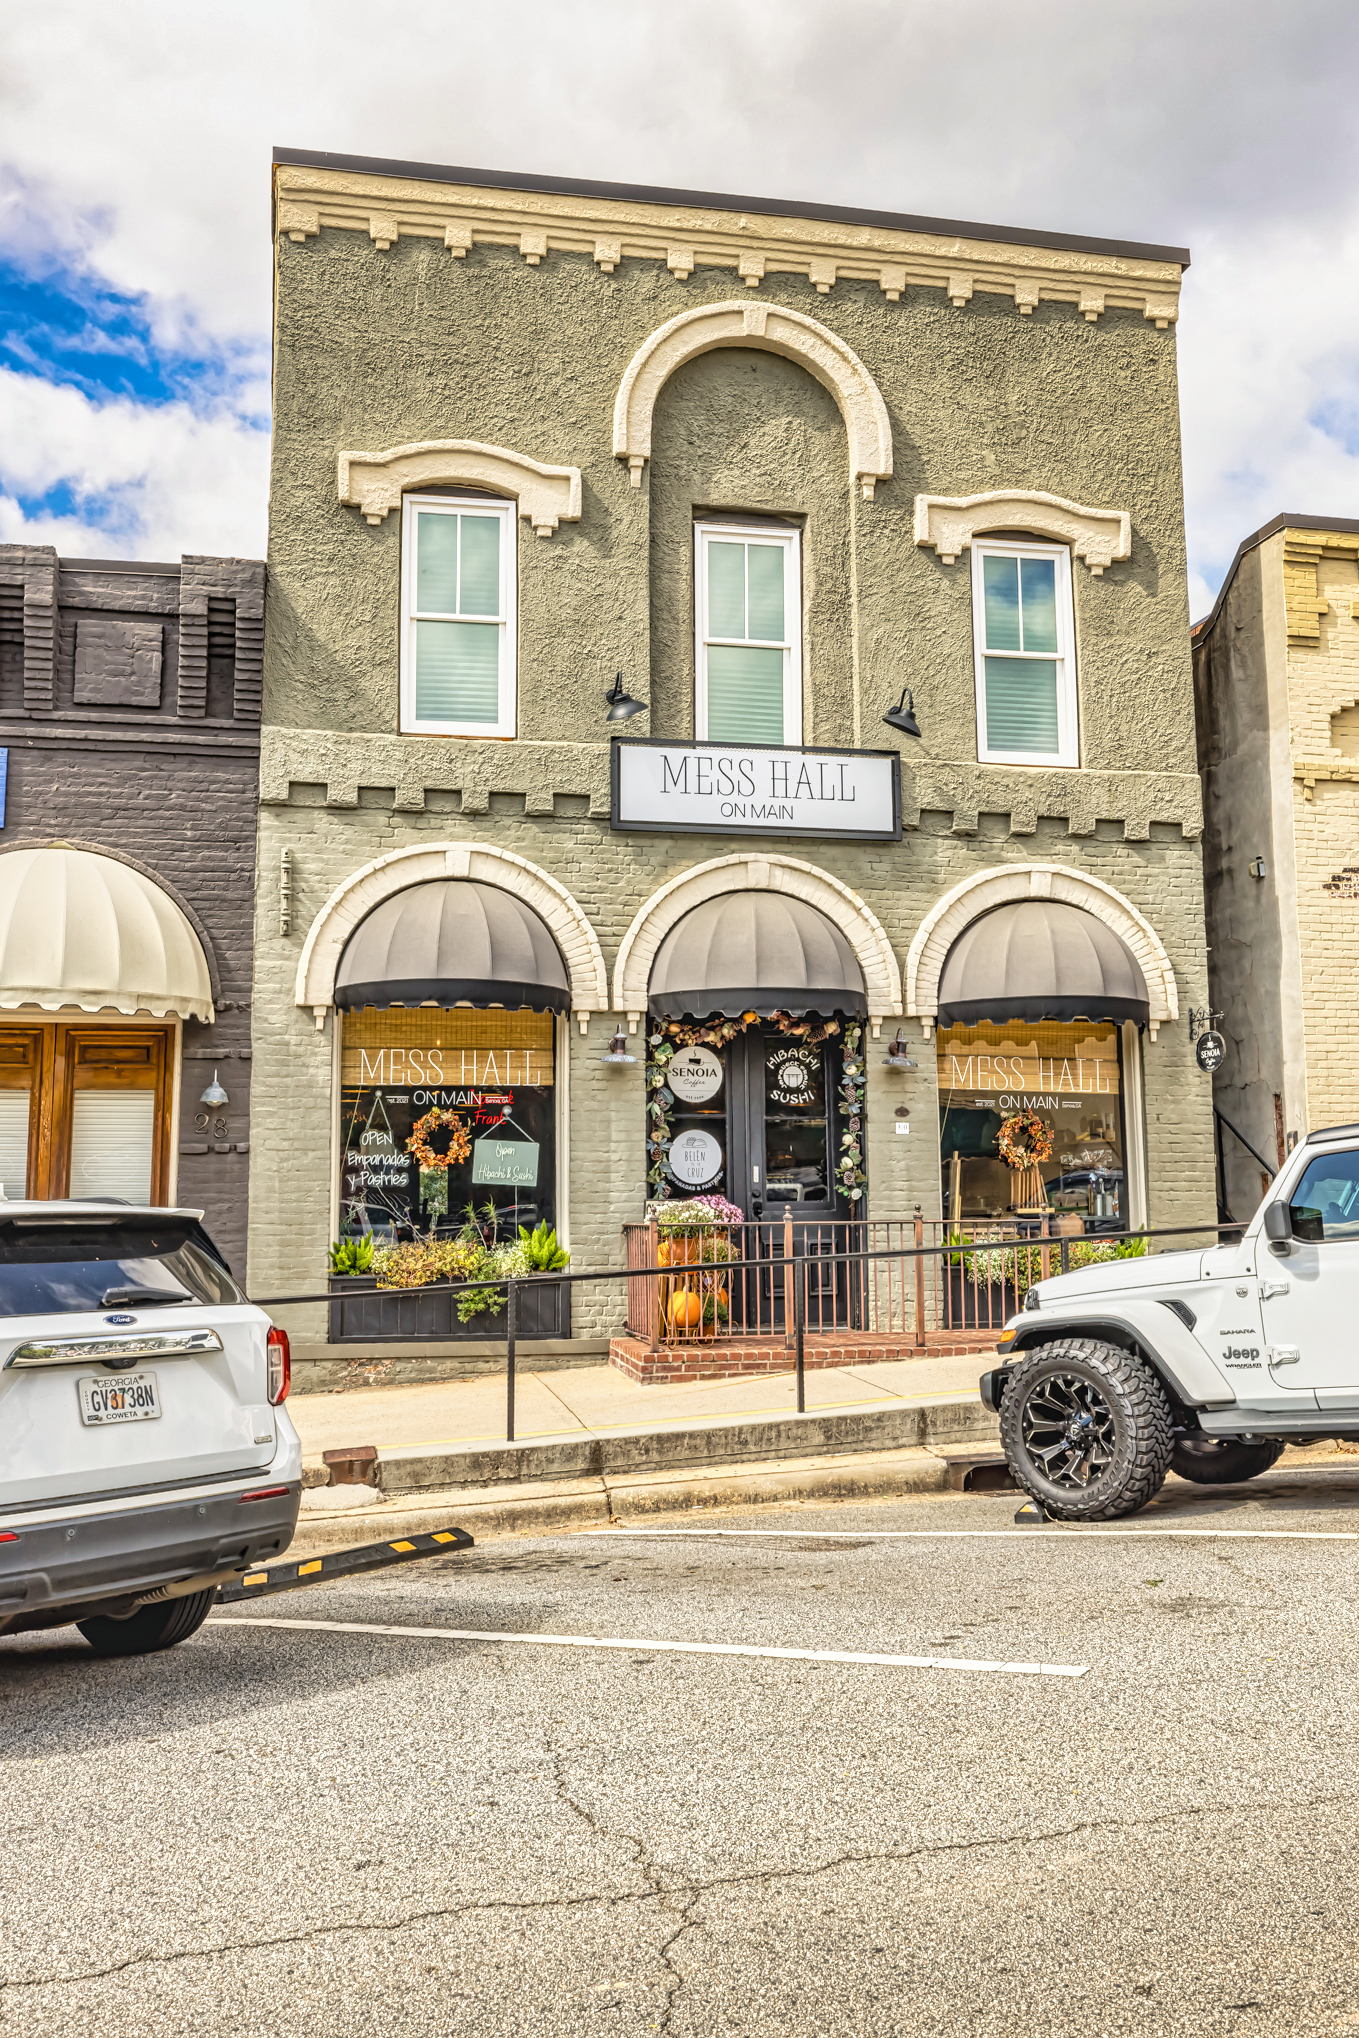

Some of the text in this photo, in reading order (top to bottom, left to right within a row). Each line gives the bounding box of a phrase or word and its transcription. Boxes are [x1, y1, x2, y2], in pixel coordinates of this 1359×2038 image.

[660, 754, 856, 802] MESS HALL
[720, 802, 794, 820] ON MAIN
[766, 1047, 820, 1070] HIBACHI
[1201, 1048, 1220, 1059] SENOIA
[357, 1049, 540, 1086] MESS HALL
[671, 1067, 718, 1078] SENOIA
[949, 1055, 1110, 1093] MESS HALL
[683, 1078, 706, 1088] Coffee
[413, 1090, 481, 1105] ON MAIN
[770, 1089, 815, 1104] SUSHI
[999, 1095, 1059, 1109] ON MAIN
[194, 1112, 229, 1139] 28
[361, 1131, 392, 1146] OPEN
[495, 1142, 516, 1161] Open
[347, 1149, 410, 1170] Empanadas
[347, 1169, 408, 1191] y Pastries
[478, 1163, 534, 1183] Hibachi & Sushi
[687, 1167, 704, 1178] CRUZ
[112, 1315, 131, 1324] Ford
[1222, 1346, 1260, 1361] Jeep
[97, 1377, 140, 1388] GEORGIA
[91, 1385, 155, 1412] GV3738N
[106, 1411, 138, 1419] COWETA
